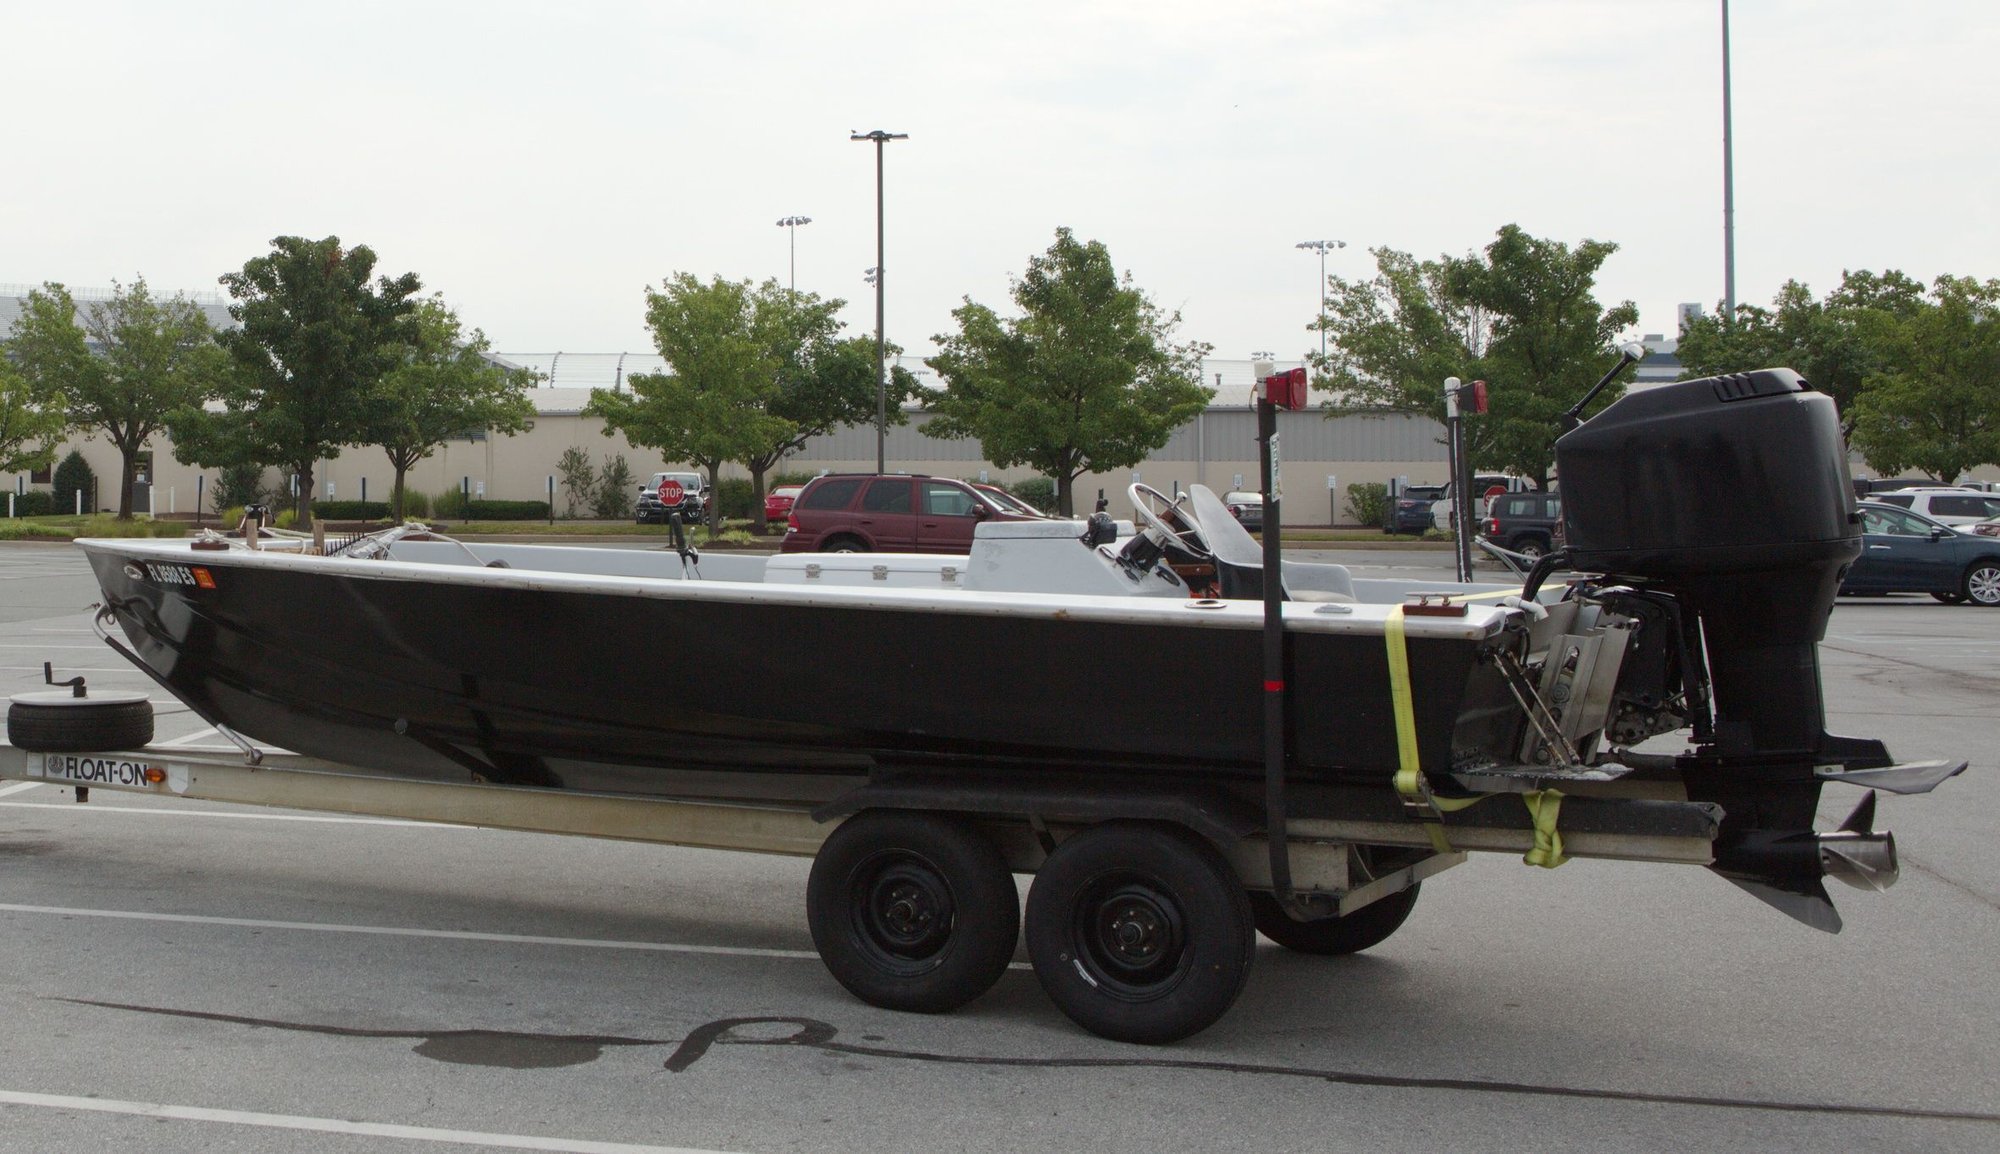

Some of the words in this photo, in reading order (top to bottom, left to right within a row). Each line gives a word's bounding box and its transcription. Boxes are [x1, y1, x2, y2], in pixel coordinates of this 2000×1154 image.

[660, 487, 682, 498] STOP
[146, 563, 162, 582] FL
[177, 566, 196, 586] ES
[66, 756, 147, 786] FLOAT-ON
